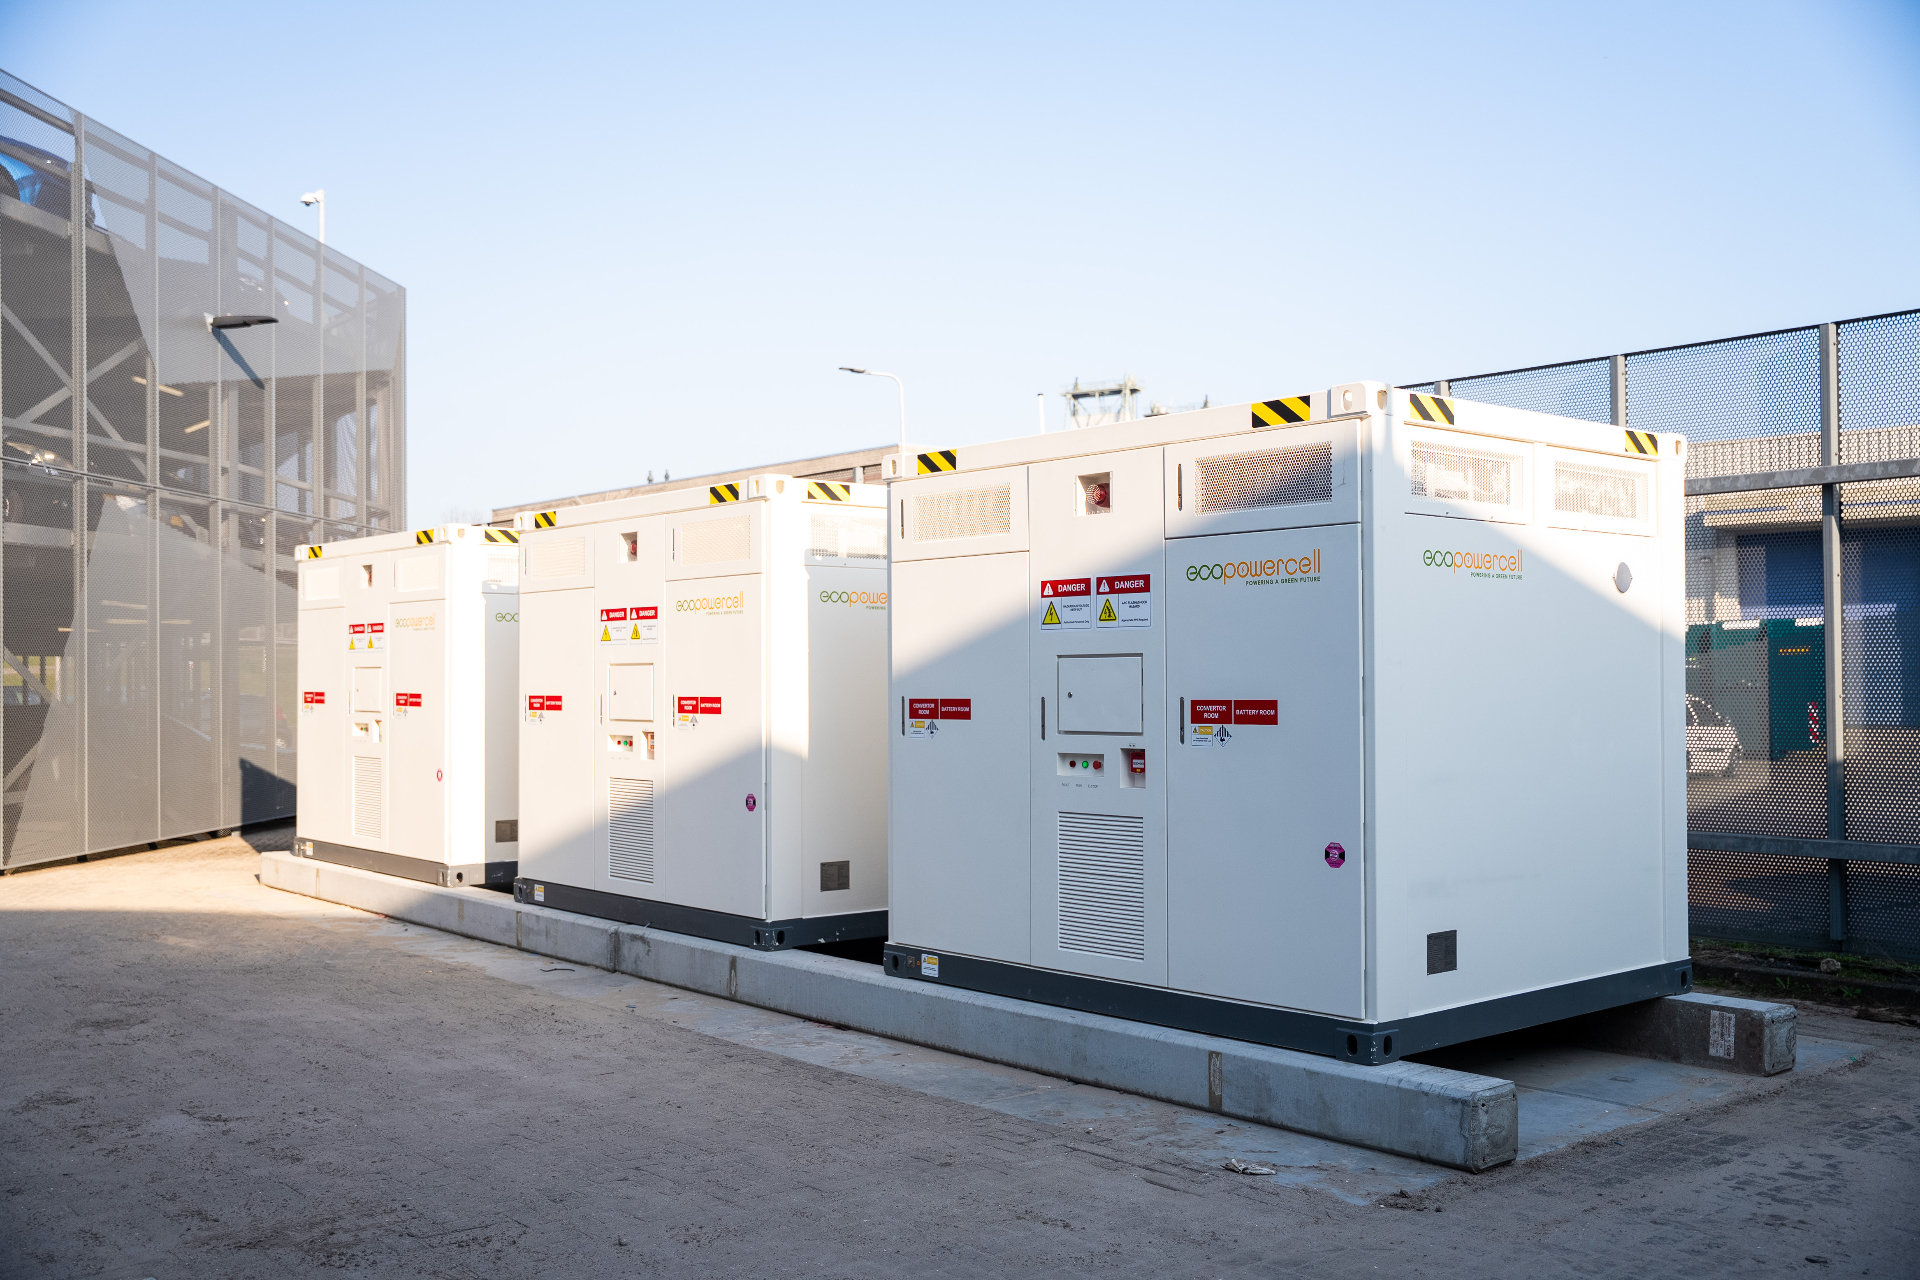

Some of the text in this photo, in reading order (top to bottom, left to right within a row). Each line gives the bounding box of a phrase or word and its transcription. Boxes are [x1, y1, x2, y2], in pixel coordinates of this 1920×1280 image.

[1186, 549, 1321, 585] ecopowercell
[1423, 549, 1523, 574] ecopowercell
[1058, 584, 1086, 592] DANGER
[1115, 580, 1145, 589] DANGER
[676, 590, 744, 615] ecopowercell
[639, 609, 656, 617] DANGER
